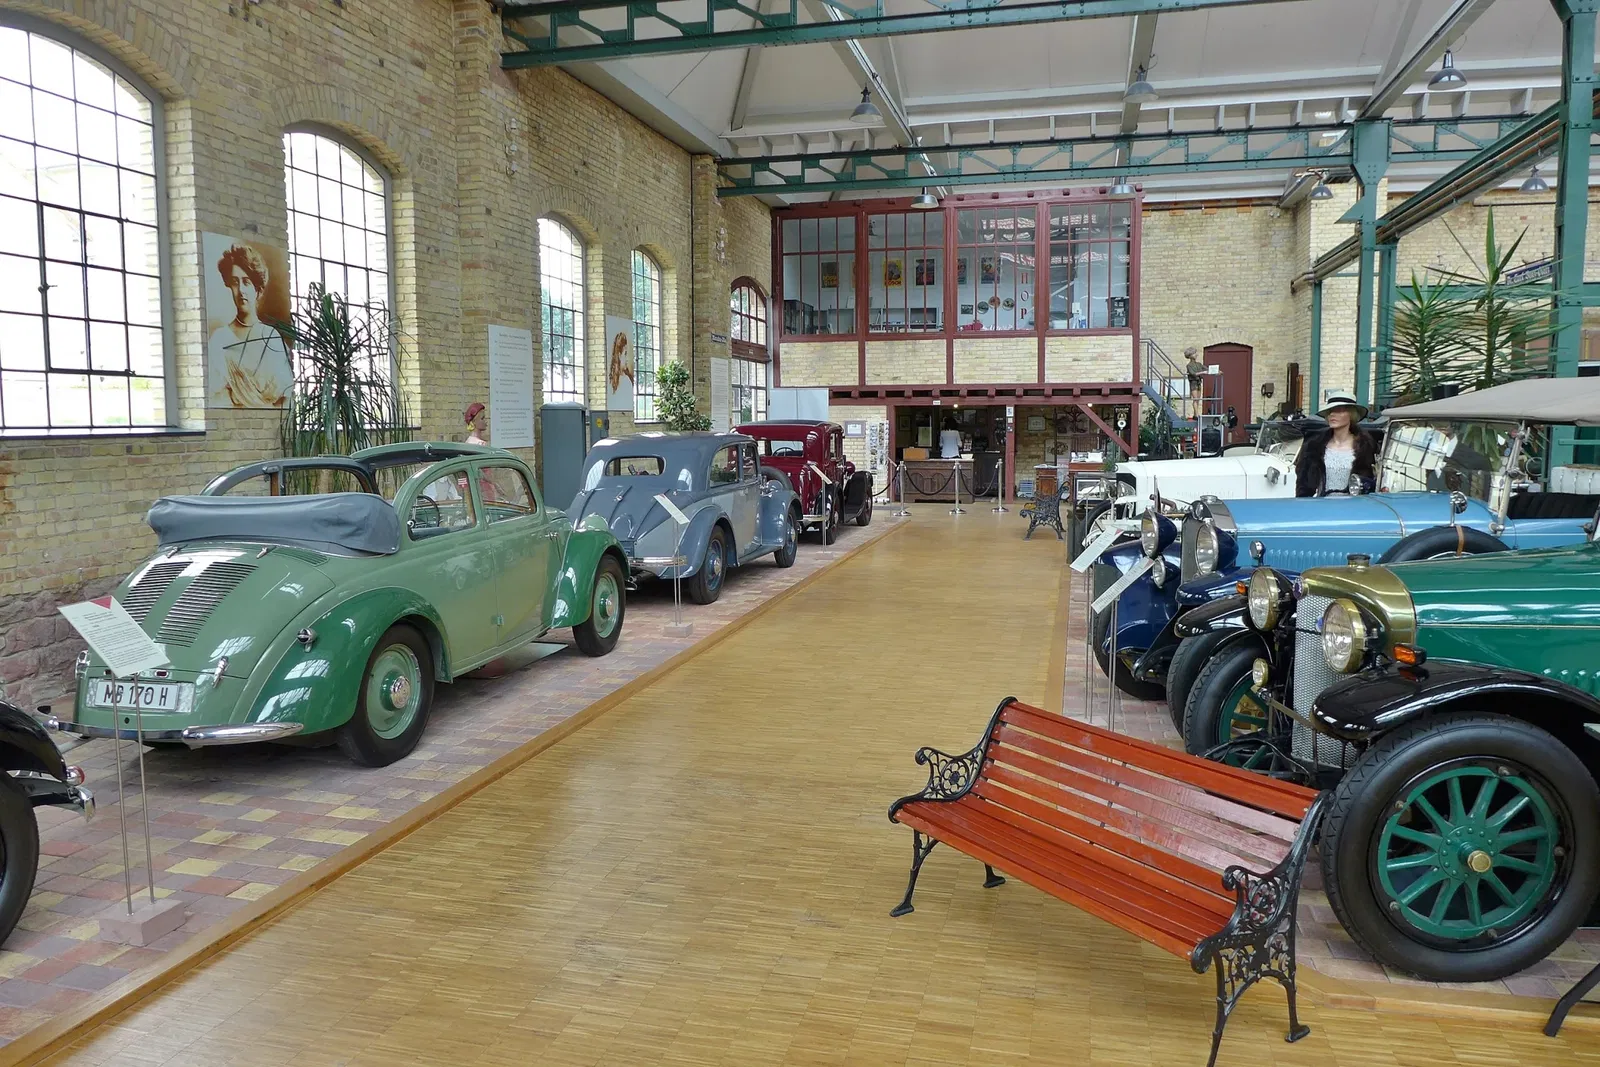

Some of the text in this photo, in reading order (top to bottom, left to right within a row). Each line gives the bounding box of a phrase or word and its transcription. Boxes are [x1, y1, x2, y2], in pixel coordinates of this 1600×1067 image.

[103, 684, 169, 707] MB 170 H
